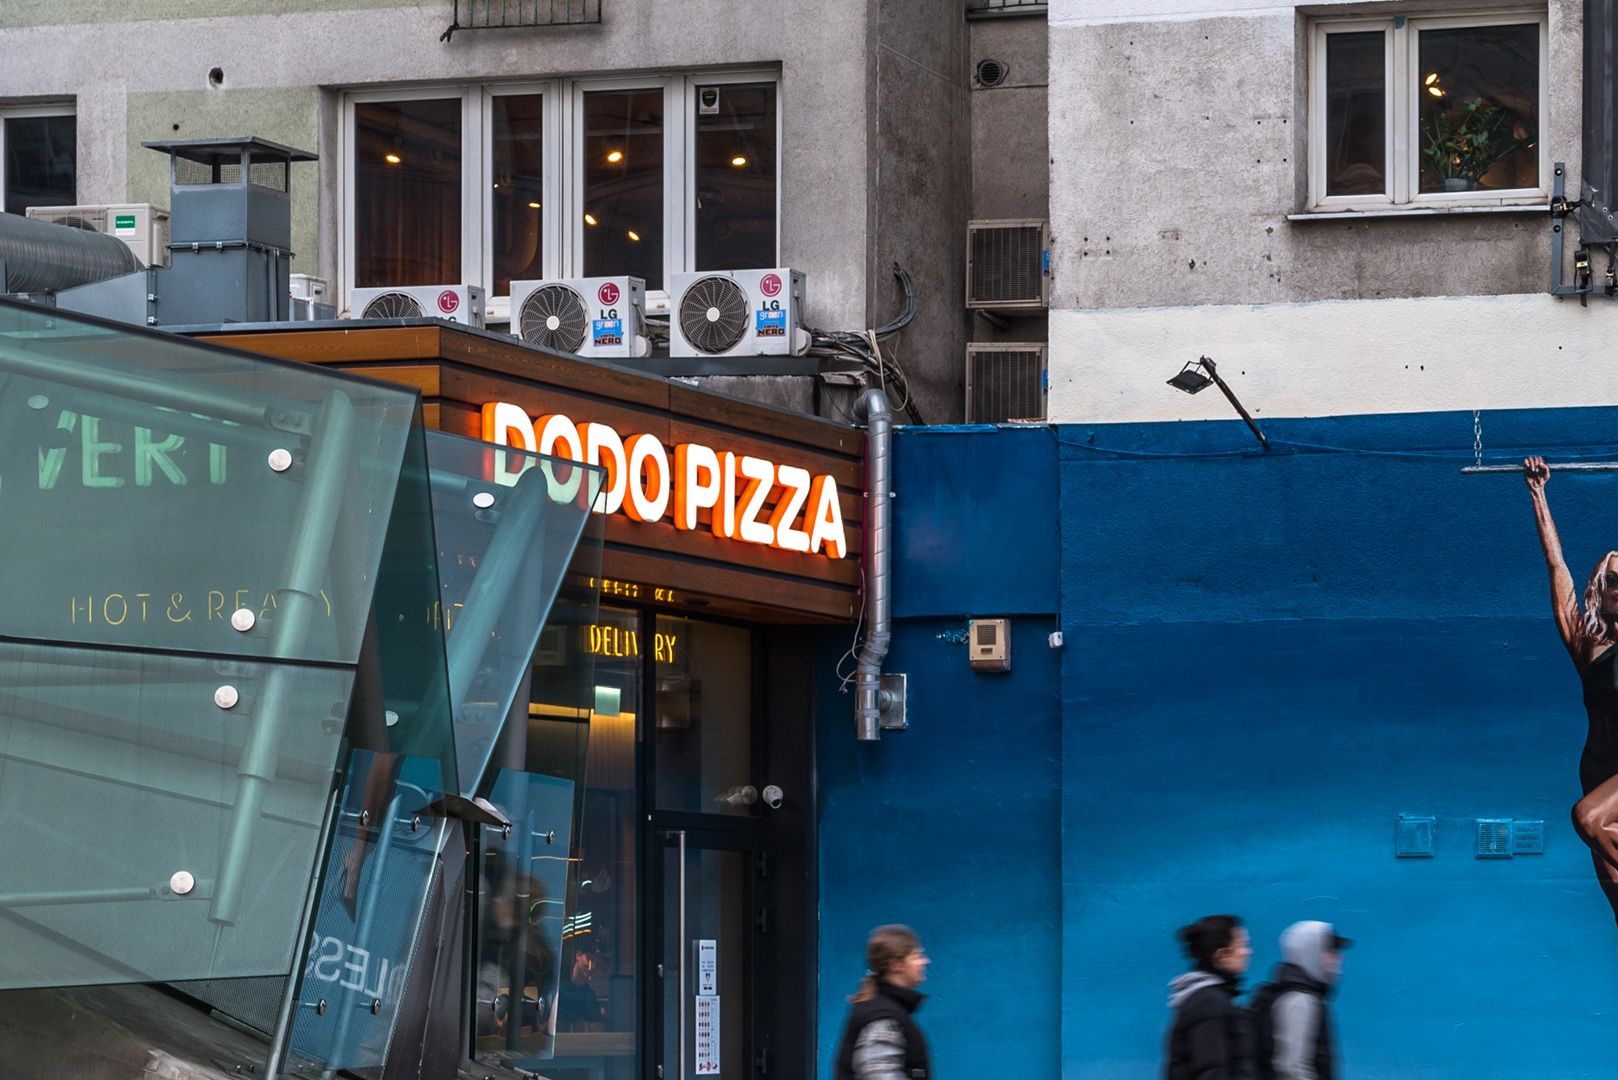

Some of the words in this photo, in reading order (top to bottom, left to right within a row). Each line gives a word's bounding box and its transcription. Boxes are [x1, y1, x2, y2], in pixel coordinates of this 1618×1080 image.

[600, 308, 618, 320] LG
[762, 299, 780, 310] LG
[482, 402, 670, 522] DODO
[674, 443, 847, 559] PIZZA
[71, 593, 150, 625] HOT
[208, 588, 331, 620] REAY
[590, 625, 676, 663] DELIRY
